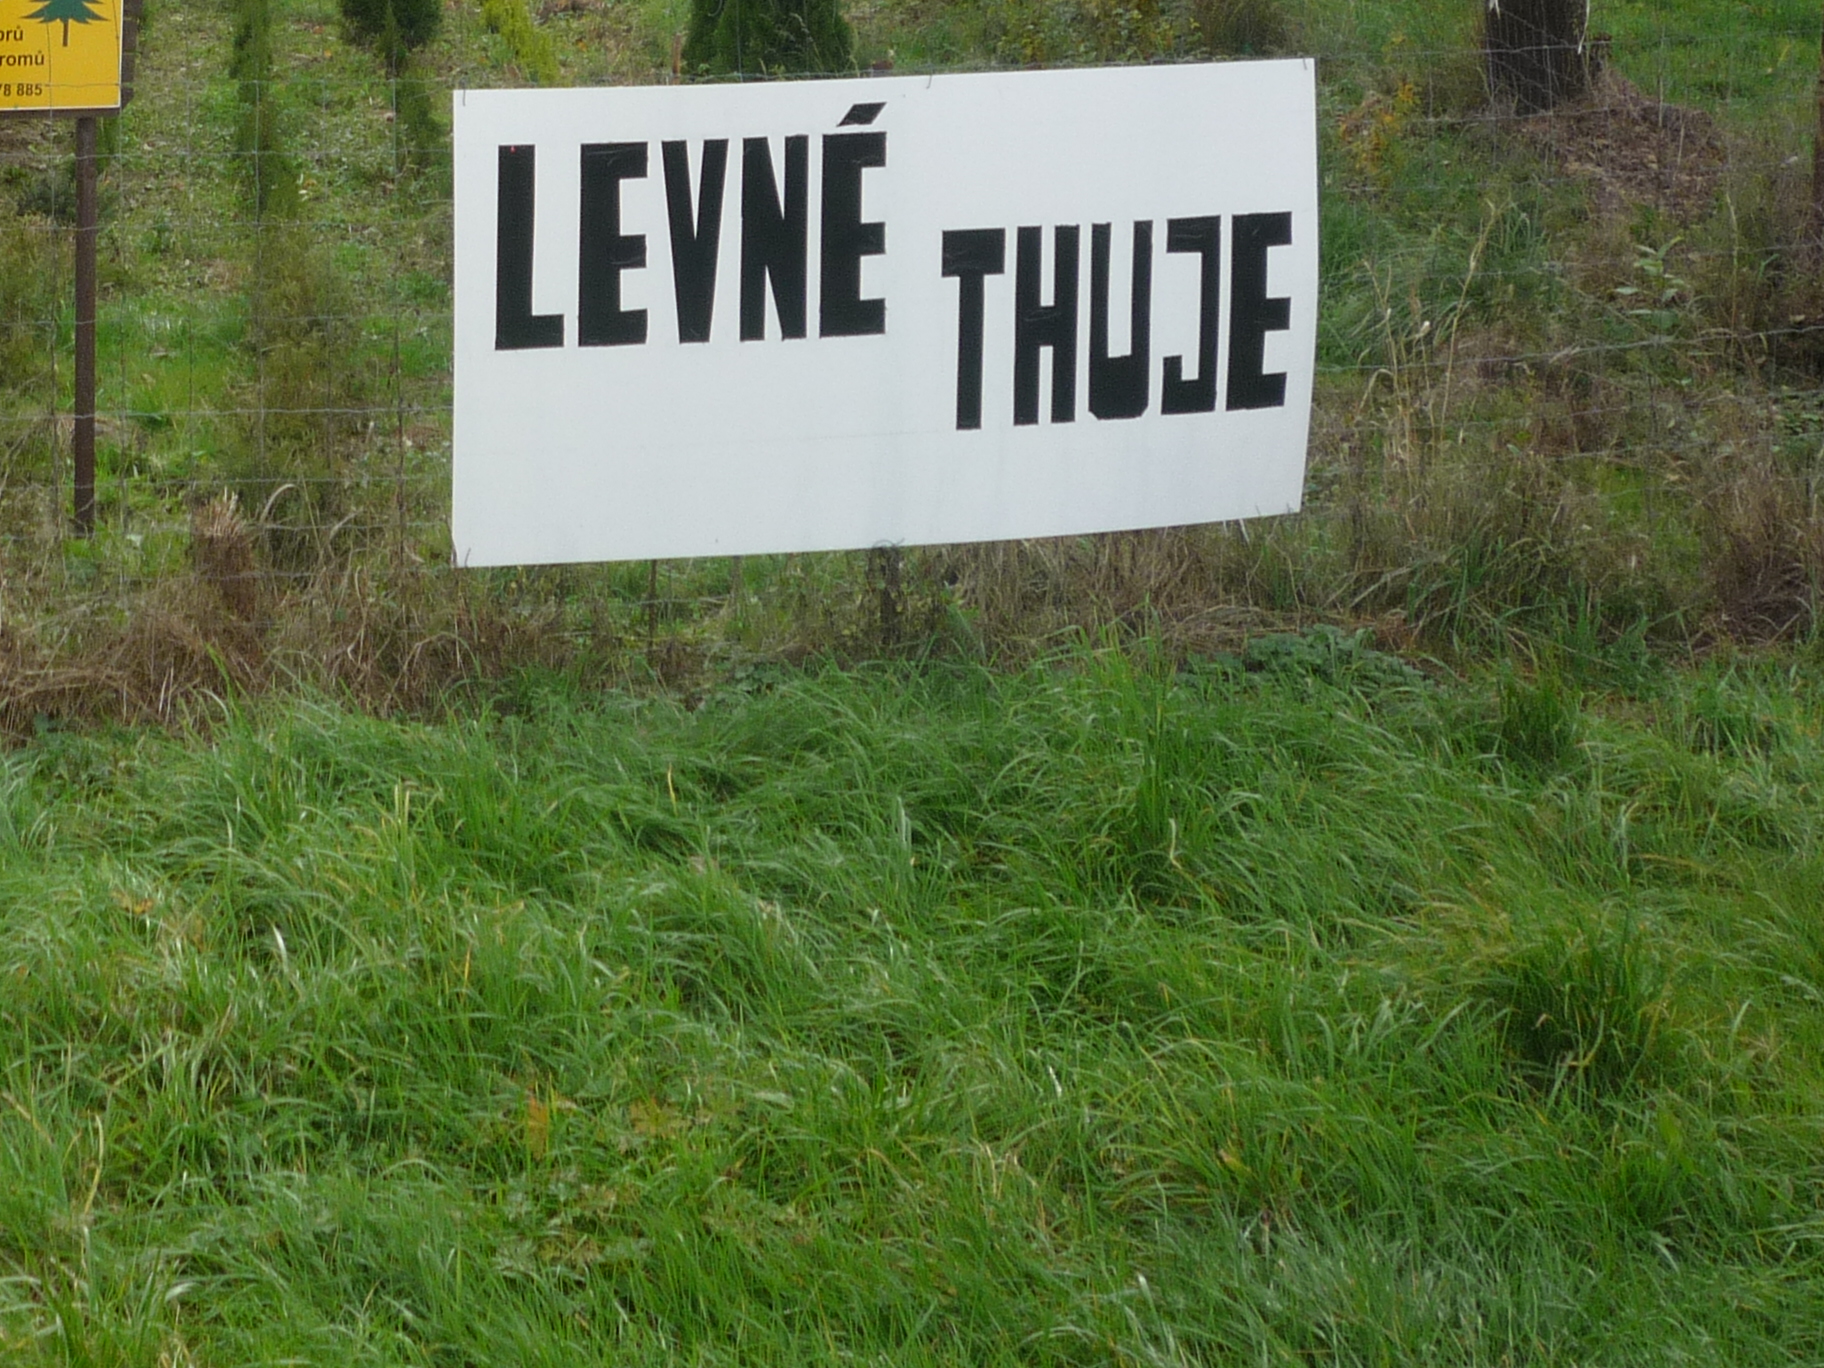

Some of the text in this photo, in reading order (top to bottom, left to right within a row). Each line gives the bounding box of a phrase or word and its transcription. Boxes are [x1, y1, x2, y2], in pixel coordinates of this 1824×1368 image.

[16, 83, 43, 97] 885
[495, 102, 1292, 430] LEVNÉ THUJE
